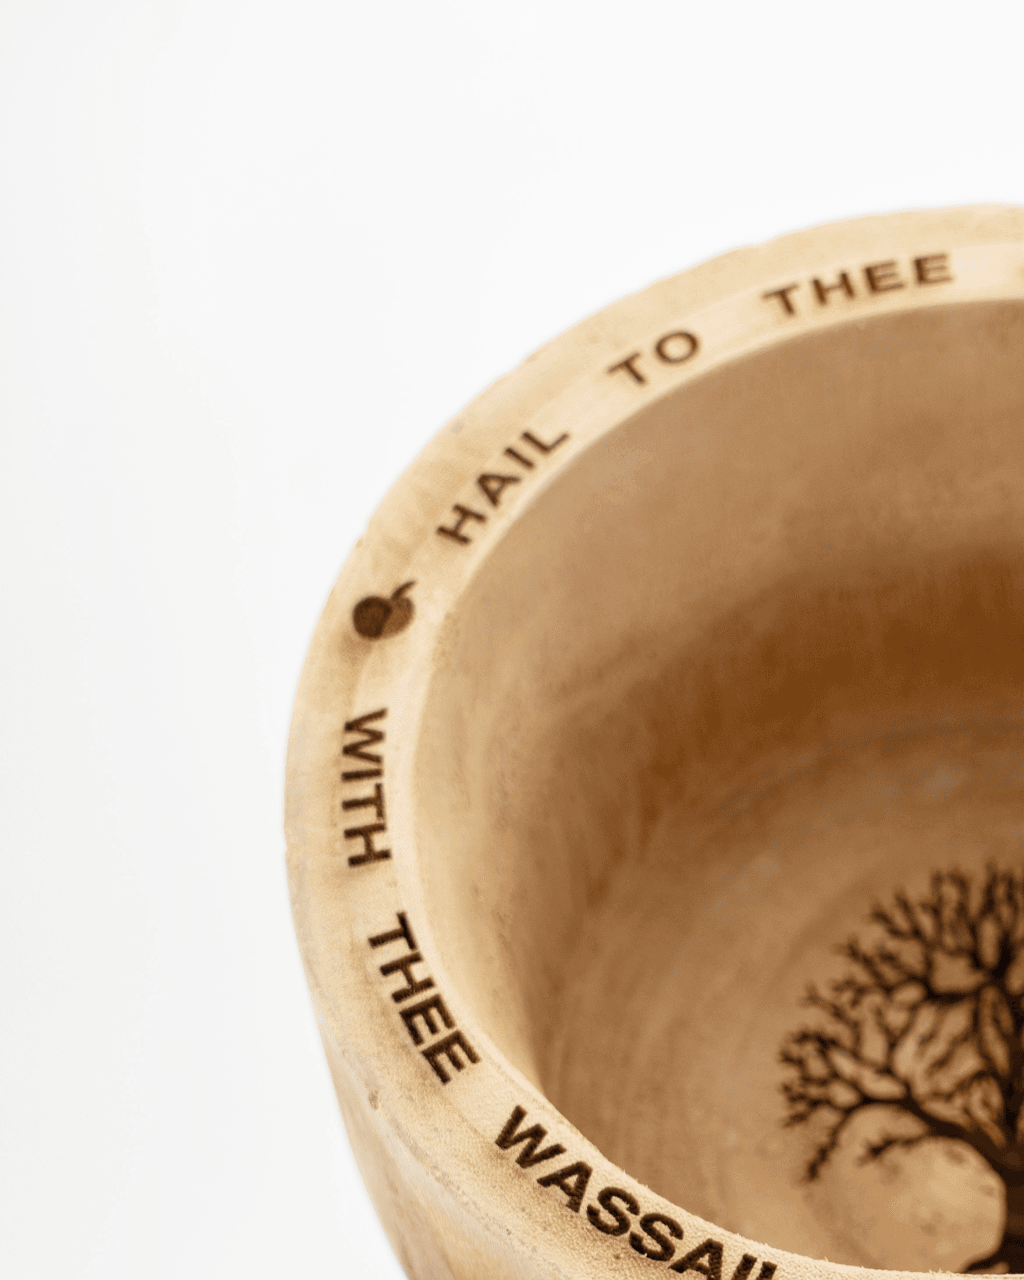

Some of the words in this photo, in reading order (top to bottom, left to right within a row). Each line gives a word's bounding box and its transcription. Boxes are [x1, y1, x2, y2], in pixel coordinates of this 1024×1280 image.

[436, 429, 571, 546] HAIL
[607, 330, 703, 387] TO
[761, 252, 955, 318] THEE
[340, 707, 392, 868] WITH
[367, 911, 480, 1086] THEE
